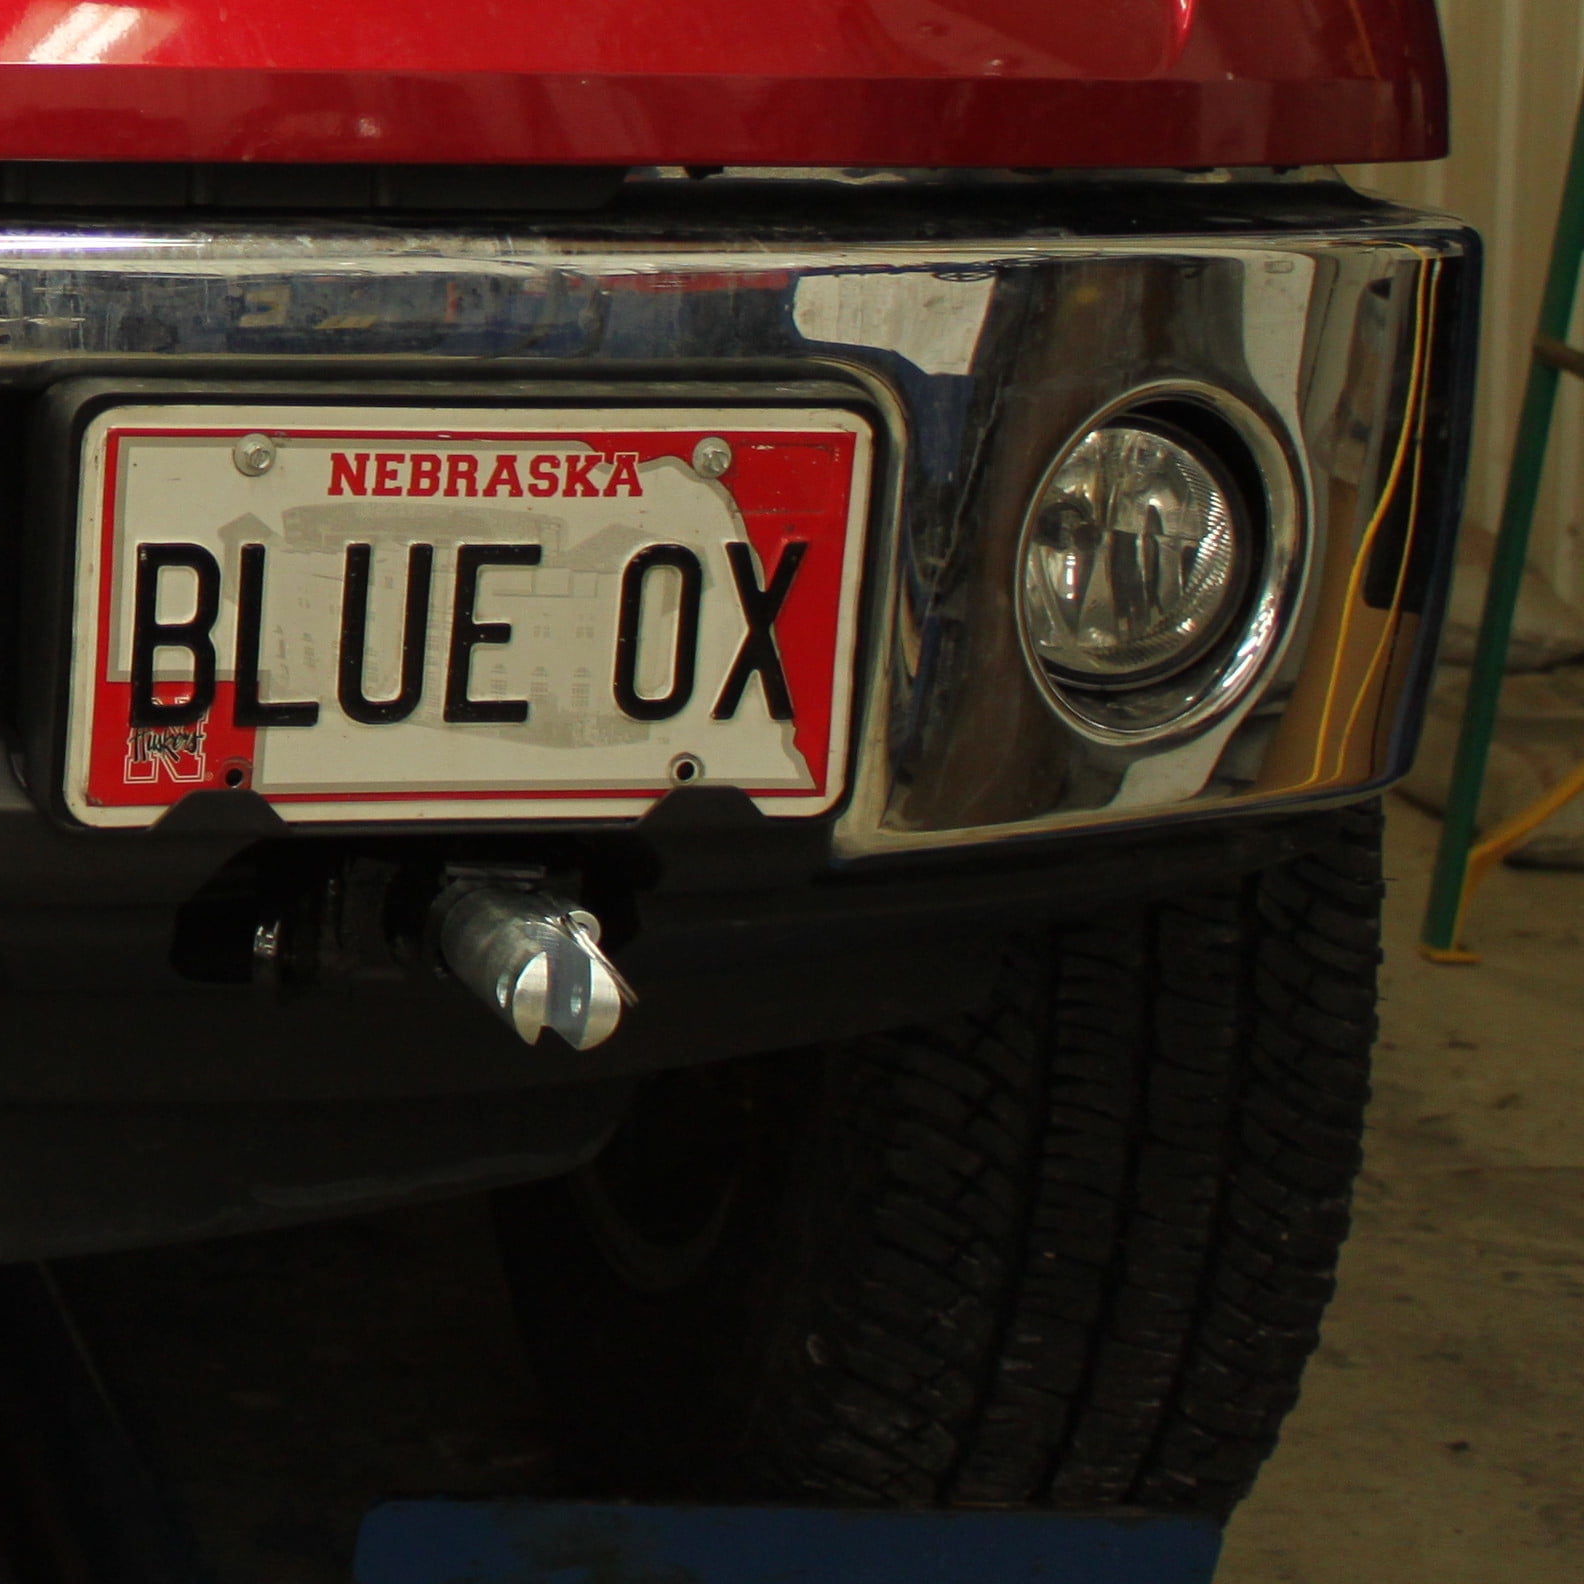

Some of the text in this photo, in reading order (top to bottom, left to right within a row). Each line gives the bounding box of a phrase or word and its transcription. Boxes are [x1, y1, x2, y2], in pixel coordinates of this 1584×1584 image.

[326, 451, 645, 499] NEBRASKA
[129, 541, 808, 729] BLUE OX
